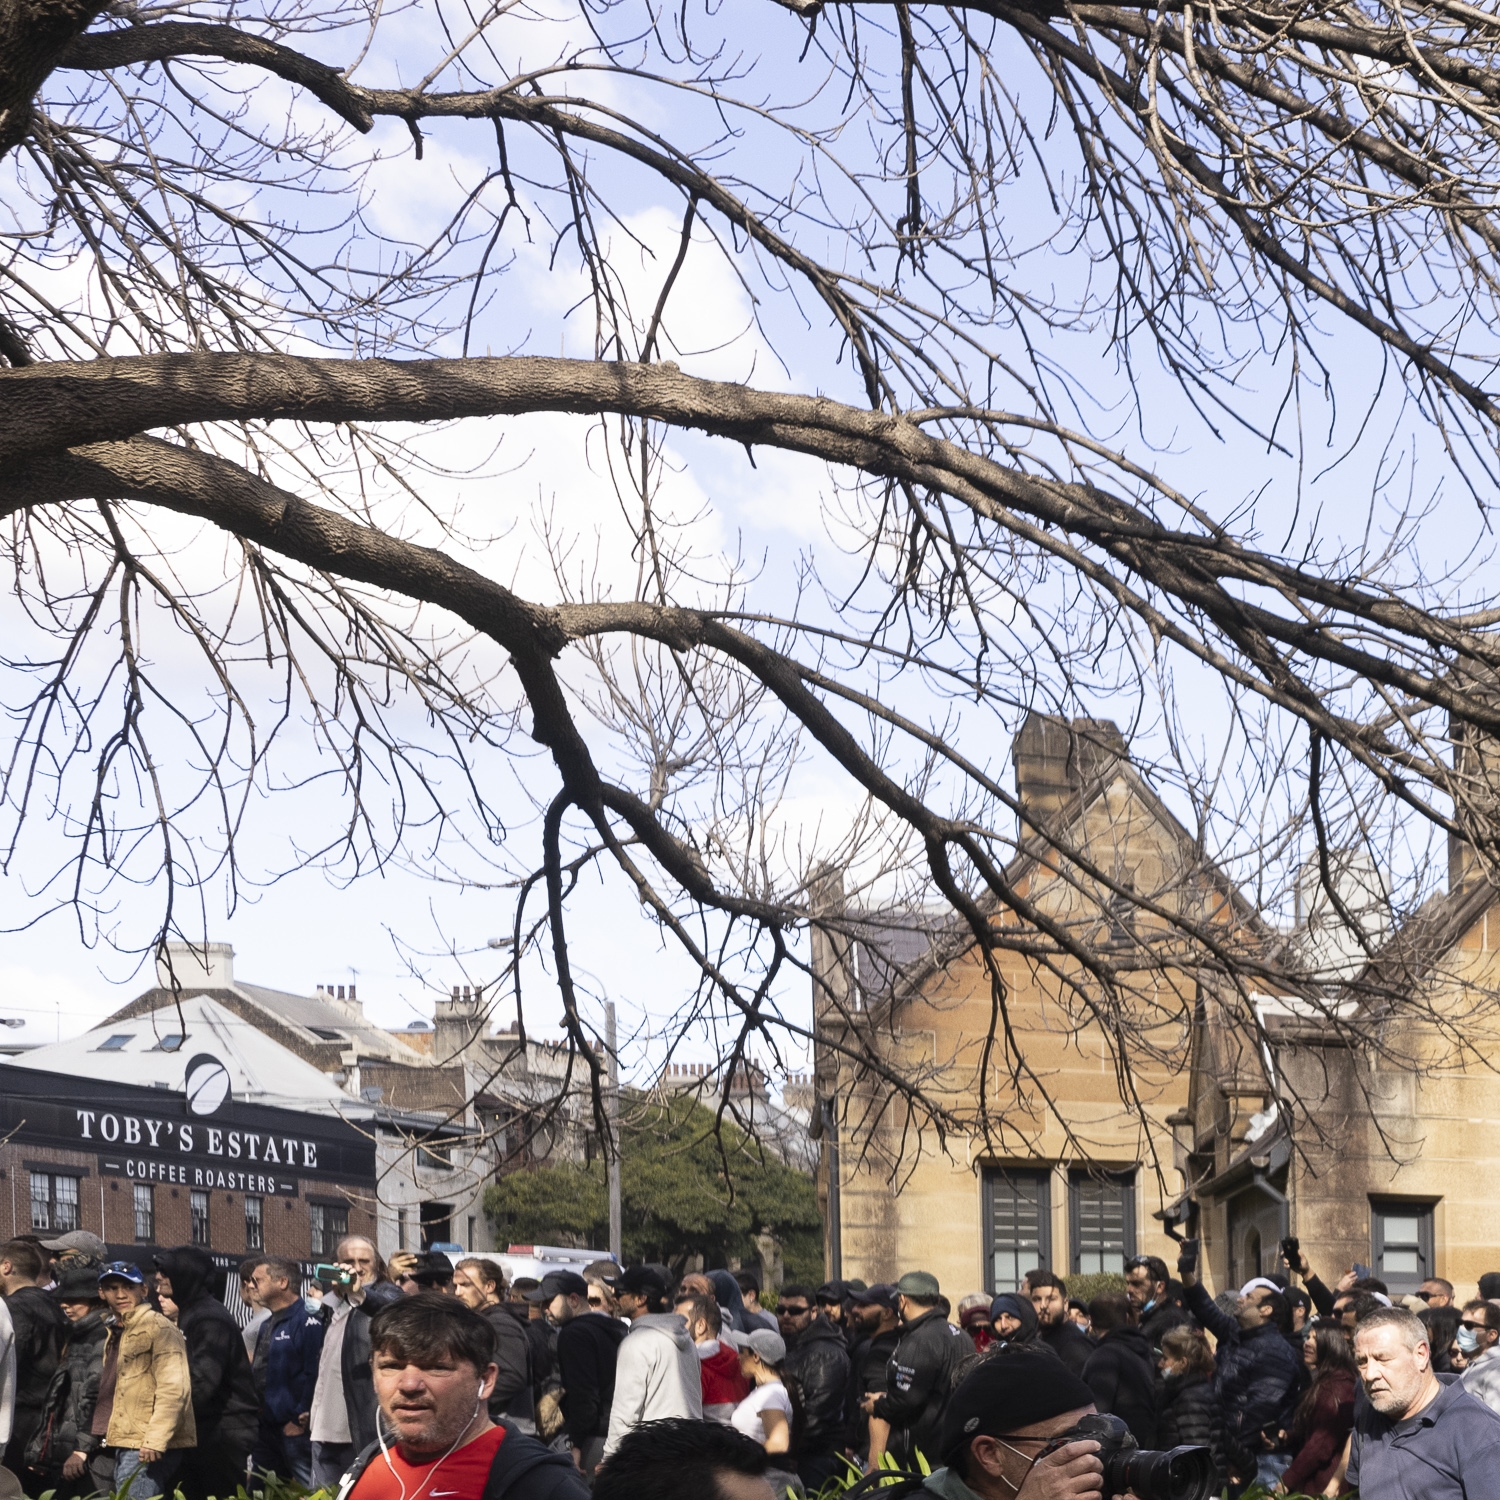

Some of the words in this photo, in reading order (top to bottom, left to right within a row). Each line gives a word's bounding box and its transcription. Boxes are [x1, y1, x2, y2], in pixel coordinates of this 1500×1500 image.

[77, 1110, 194, 1152] TOBY'S
[207, 1127, 317, 1168] ESTATE
[126, 1159, 187, 1184] COFFEE
[195, 1168, 275, 1194] ROASTERS
